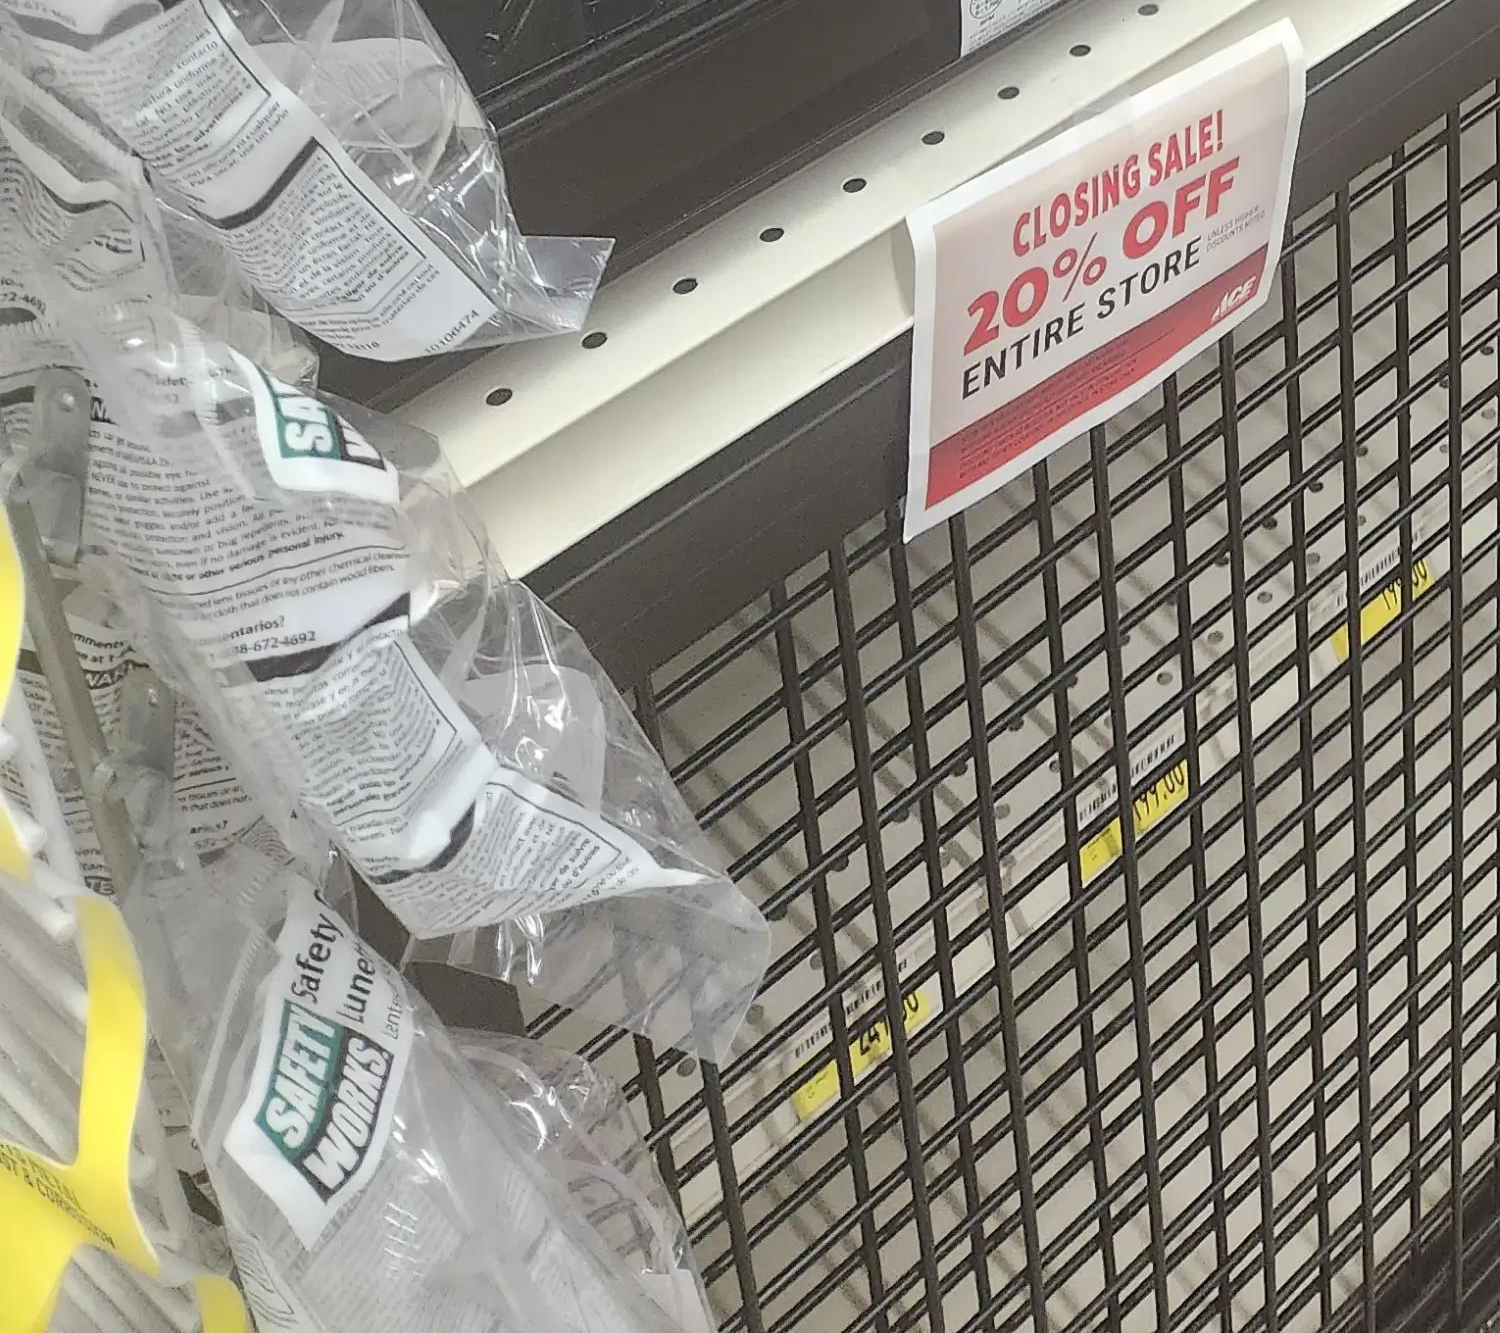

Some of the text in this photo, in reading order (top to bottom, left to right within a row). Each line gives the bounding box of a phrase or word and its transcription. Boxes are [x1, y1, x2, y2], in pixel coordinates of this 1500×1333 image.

[1012, 108, 1225, 258] CLOSING SALE!
[963, 156, 1240, 357] 20% OFF
[961, 236, 1203, 401] ENTIRE STORE
[1210, 274, 1258, 324] ACE
[203, 495, 246, 513] position
[205, 513, 226, 525] add
[192, 530, 212, 542] and
[217, 538, 238, 549] bug
[199, 568, 225, 580] other
[229, 554, 266, 573] serious
[268, 539, 311, 558] personal
[211, 554, 225, 564] no
[235, 581, 270, 601] tissues
[299, 567, 327, 582] other
[328, 553, 373, 575] chemical
[261, 590, 284, 605] does
[284, 588, 300, 599] not
[301, 577, 339, 597] contain
[339, 568, 368, 585] wood
[290, 913, 344, 1005] Safety
[265, 1004, 336, 1148] SAFETY
